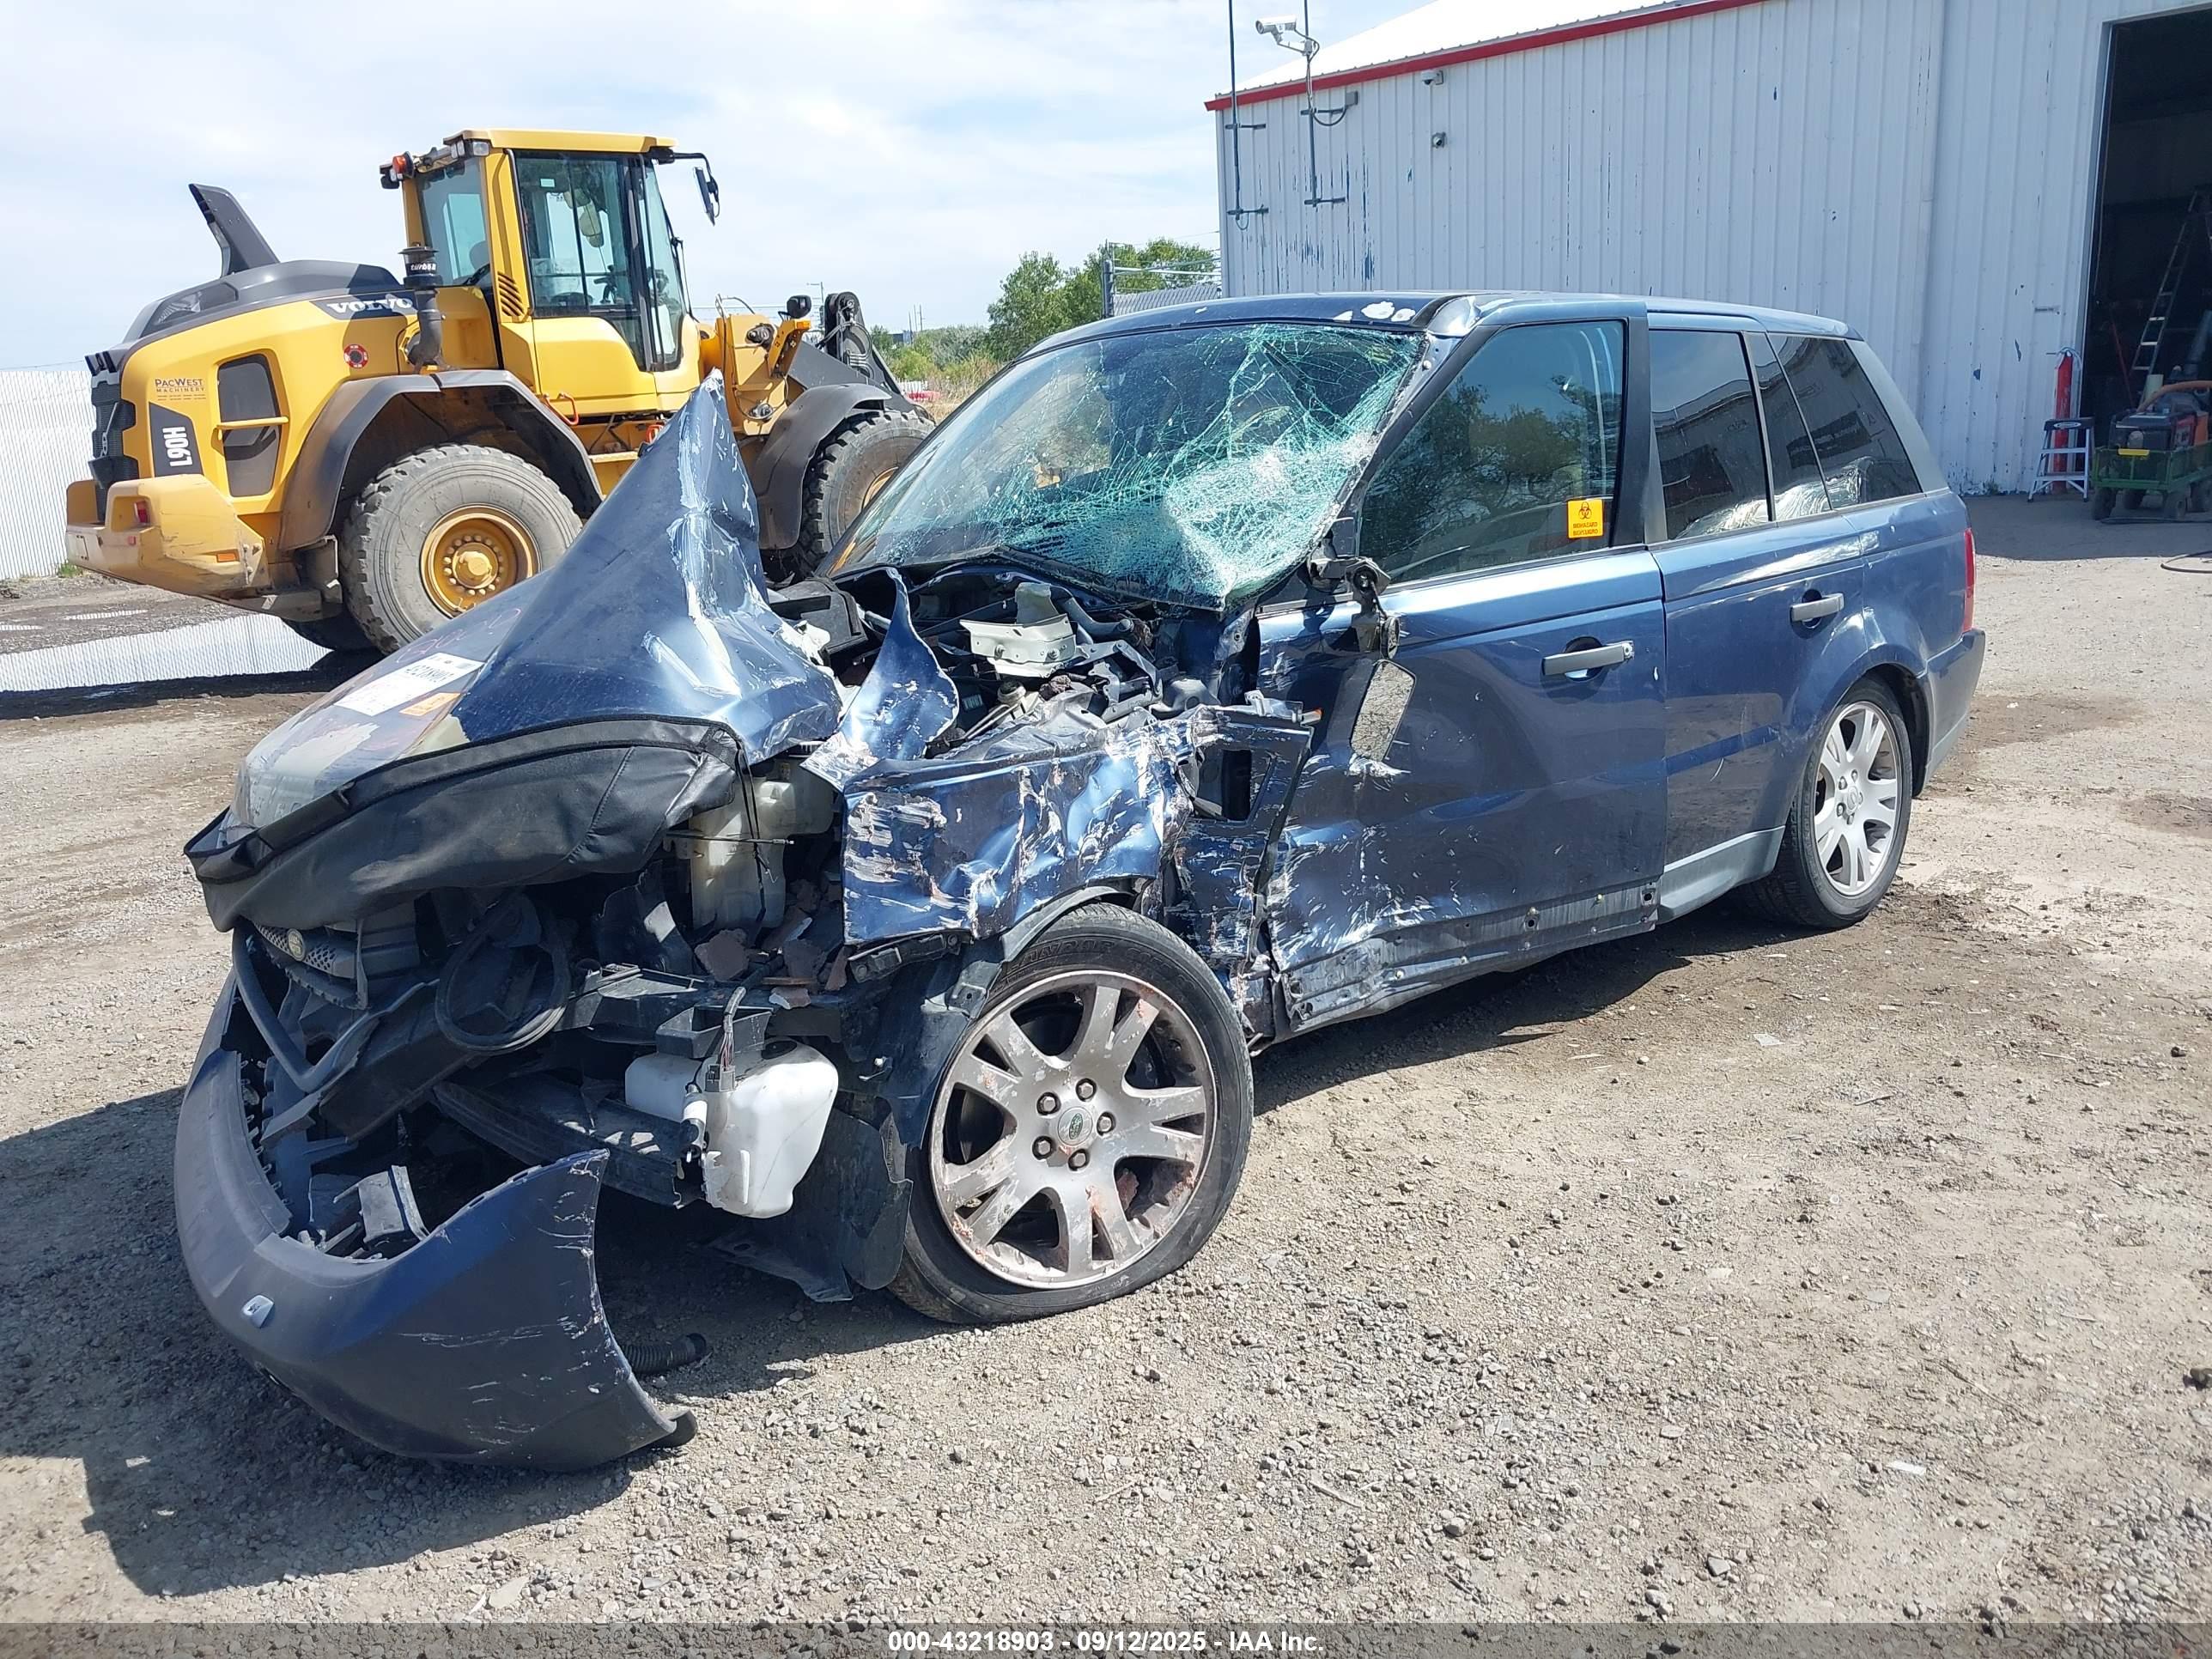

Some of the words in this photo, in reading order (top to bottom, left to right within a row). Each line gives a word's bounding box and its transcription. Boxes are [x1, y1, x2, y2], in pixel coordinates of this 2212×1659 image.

[410, 262, 431, 271] turbo
[326, 297, 412, 313] VOLVO
[162, 426, 193, 466] L90H
